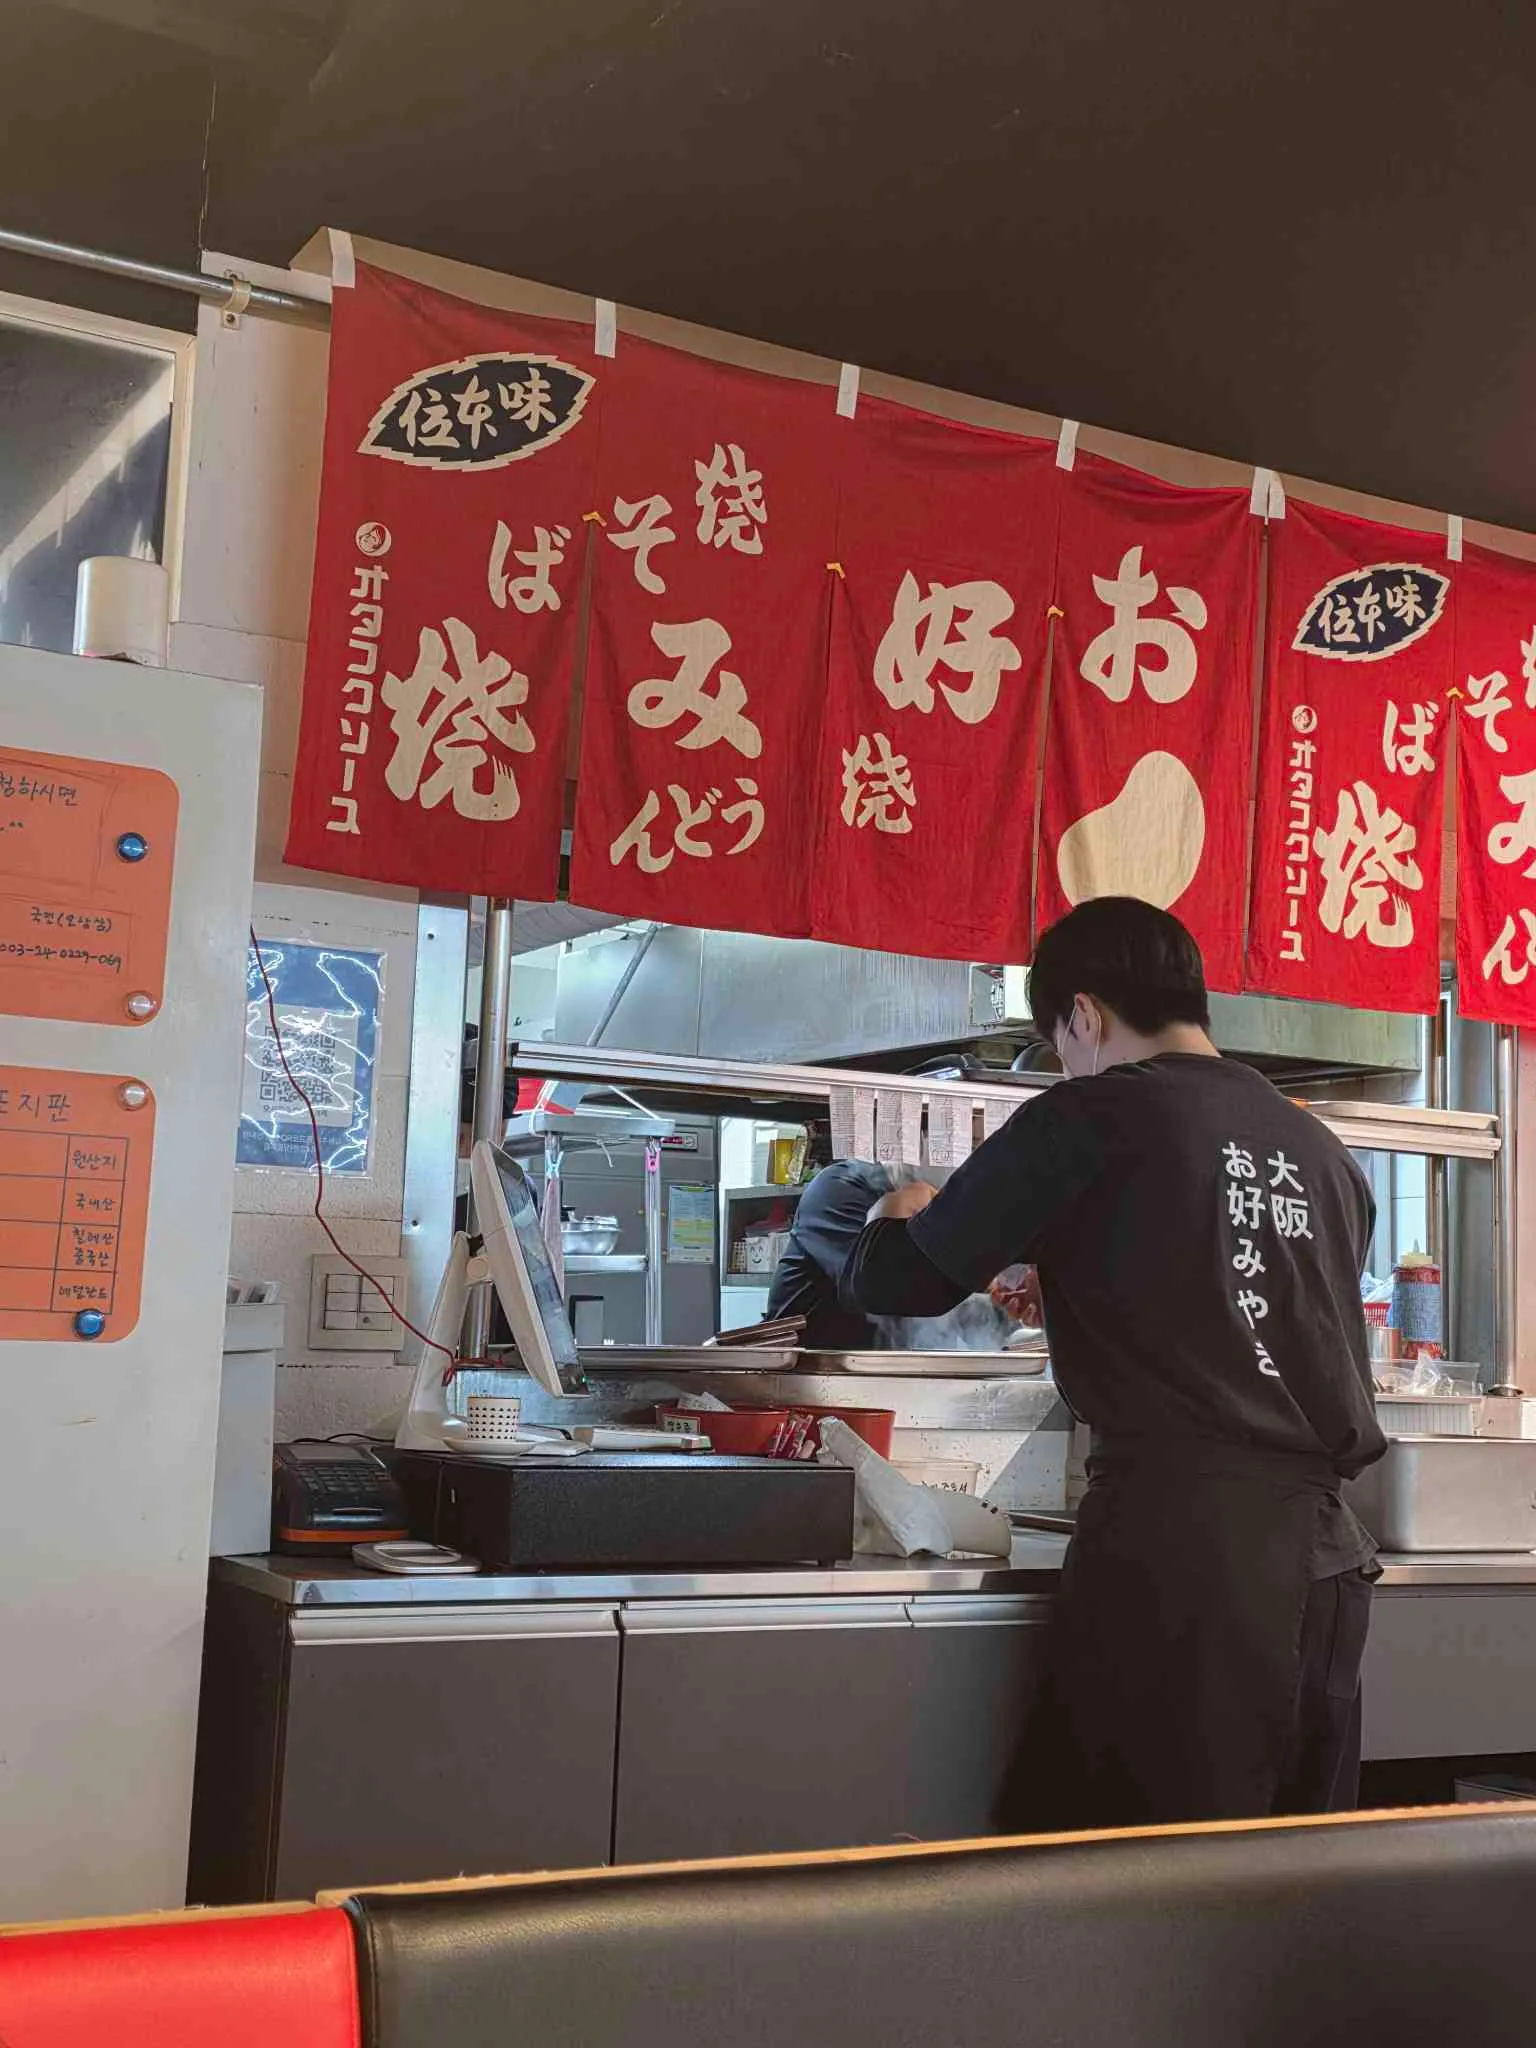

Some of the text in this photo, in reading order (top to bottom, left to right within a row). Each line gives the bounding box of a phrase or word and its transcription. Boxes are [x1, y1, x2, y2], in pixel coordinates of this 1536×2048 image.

[327, 564, 389, 835] オタフクソース
[1279, 740, 1317, 962] オタフクソース
[72, 1150, 116, 1170] 원산지
[76, 1193, 115, 1211] 국내산
[1267, 1150, 1314, 1241] 大阪
